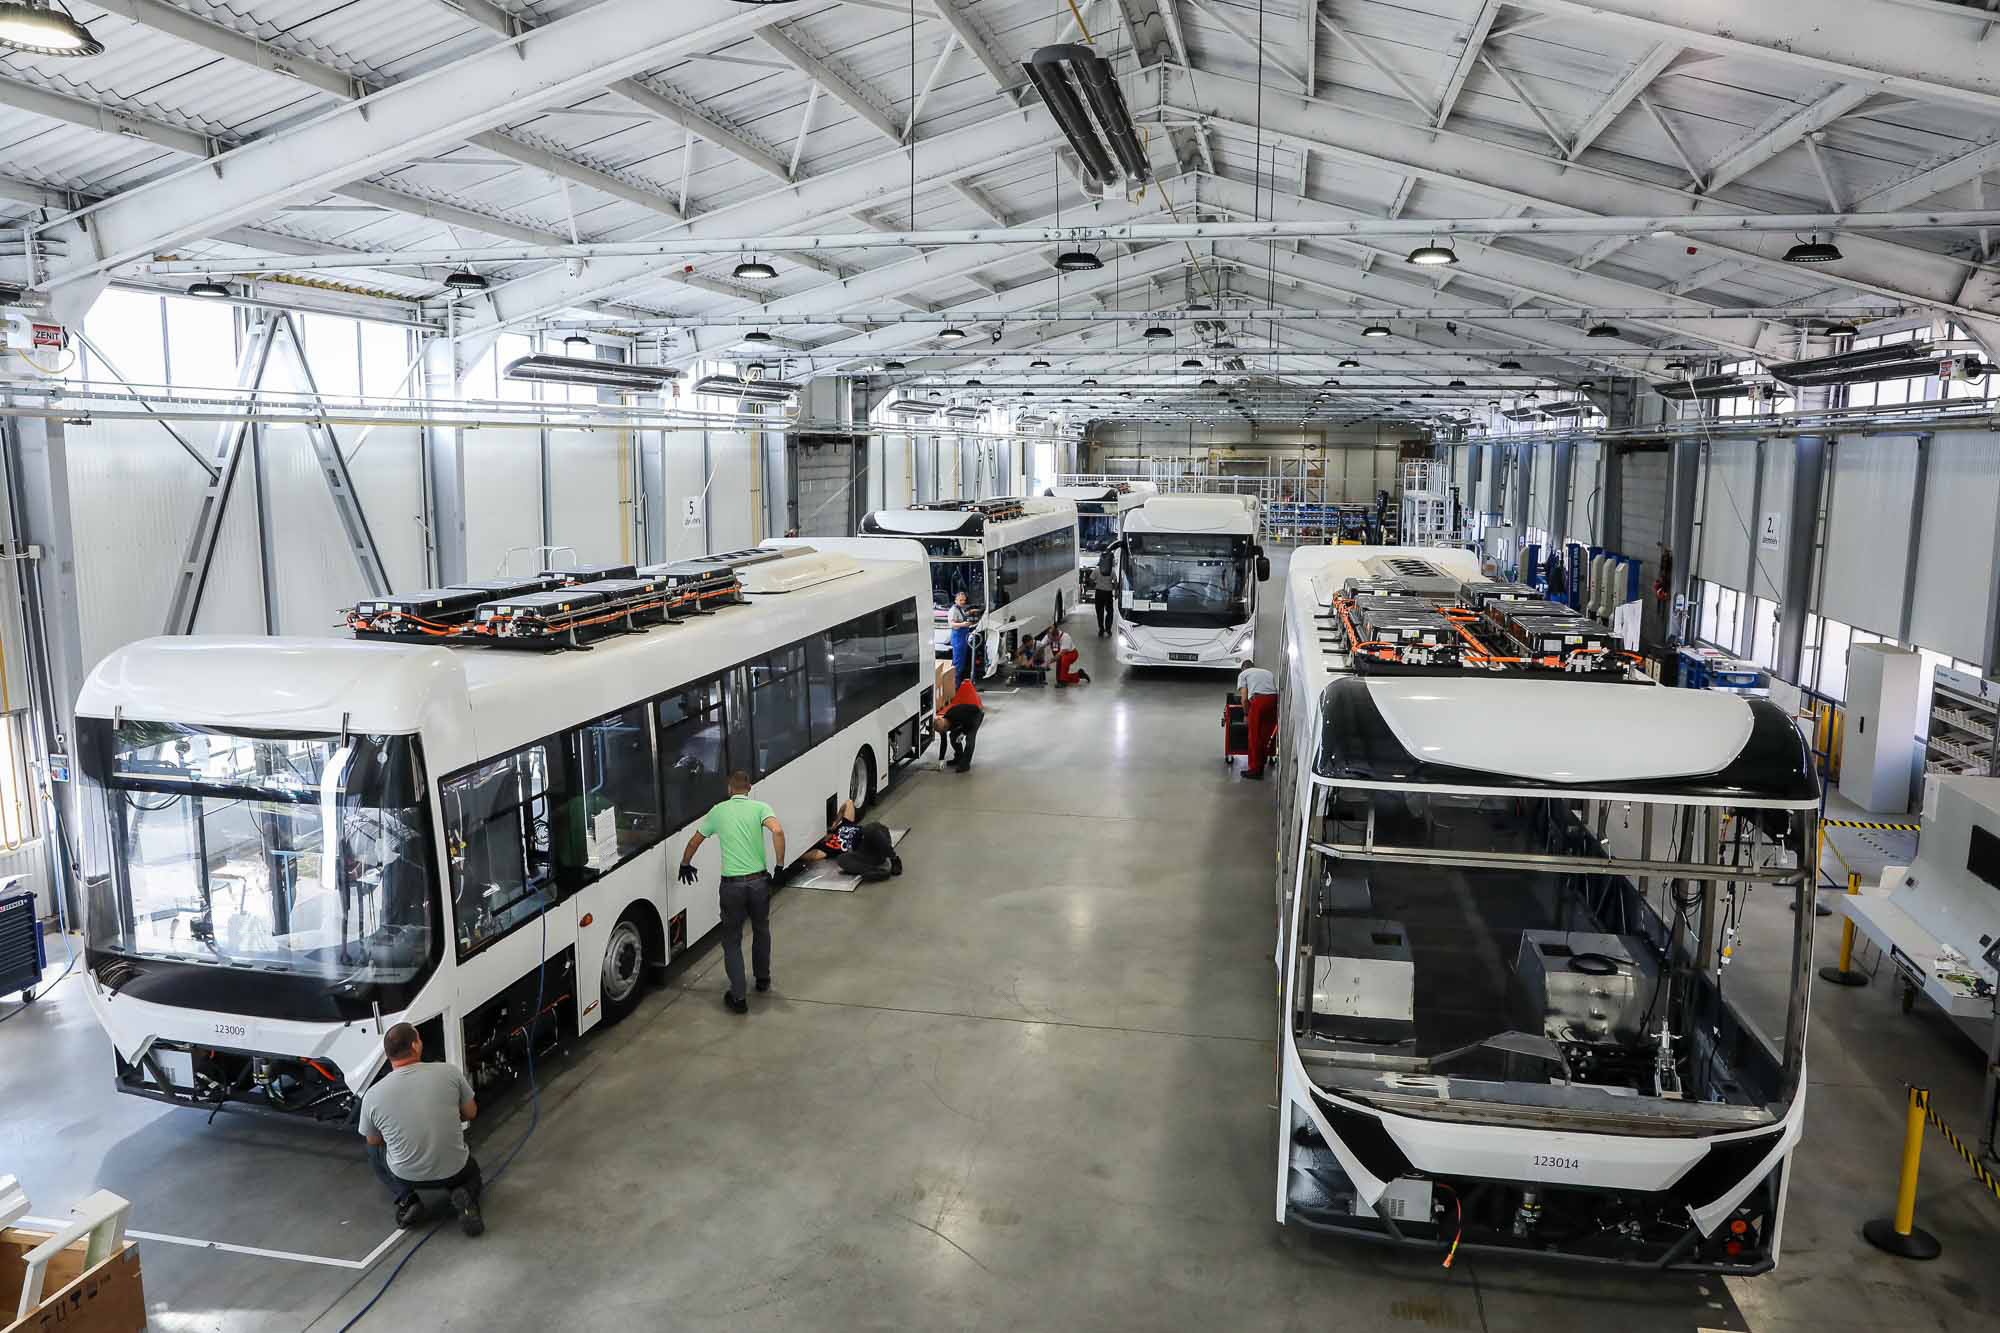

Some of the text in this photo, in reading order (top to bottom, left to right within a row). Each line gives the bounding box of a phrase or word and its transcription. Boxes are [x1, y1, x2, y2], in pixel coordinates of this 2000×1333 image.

[35, 330, 60, 341] ZENIT
[215, 1024, 245, 1036] 123009
[1534, 1155, 1578, 1169] 123014
